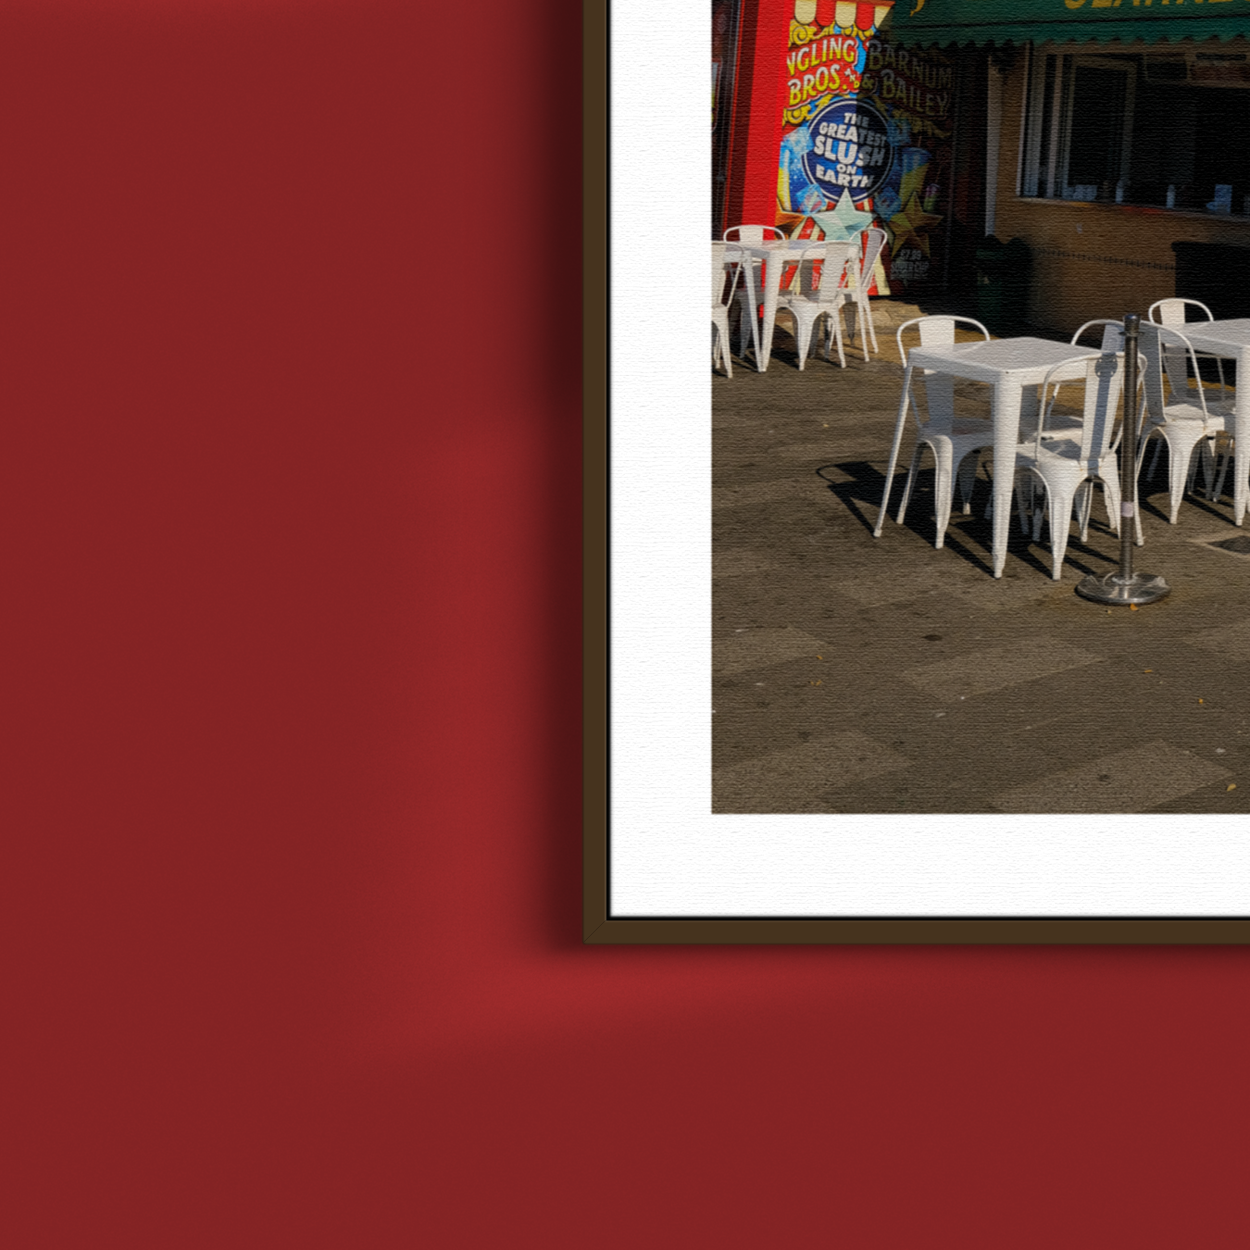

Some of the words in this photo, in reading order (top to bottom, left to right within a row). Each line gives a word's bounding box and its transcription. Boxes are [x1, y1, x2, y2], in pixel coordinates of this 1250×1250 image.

[868, 39, 951, 90] BARNUM
[787, 63, 848, 107] BROS.
[861, 73, 874, 90] &
[880, 69, 949, 116] BAILEY
[844, 112, 870, 126] THE
[818, 121, 887, 146] GREATEST
[814, 135, 886, 167] SLUSH
[815, 164, 876, 189] EARTH
[836, 164, 857, 176] ON
